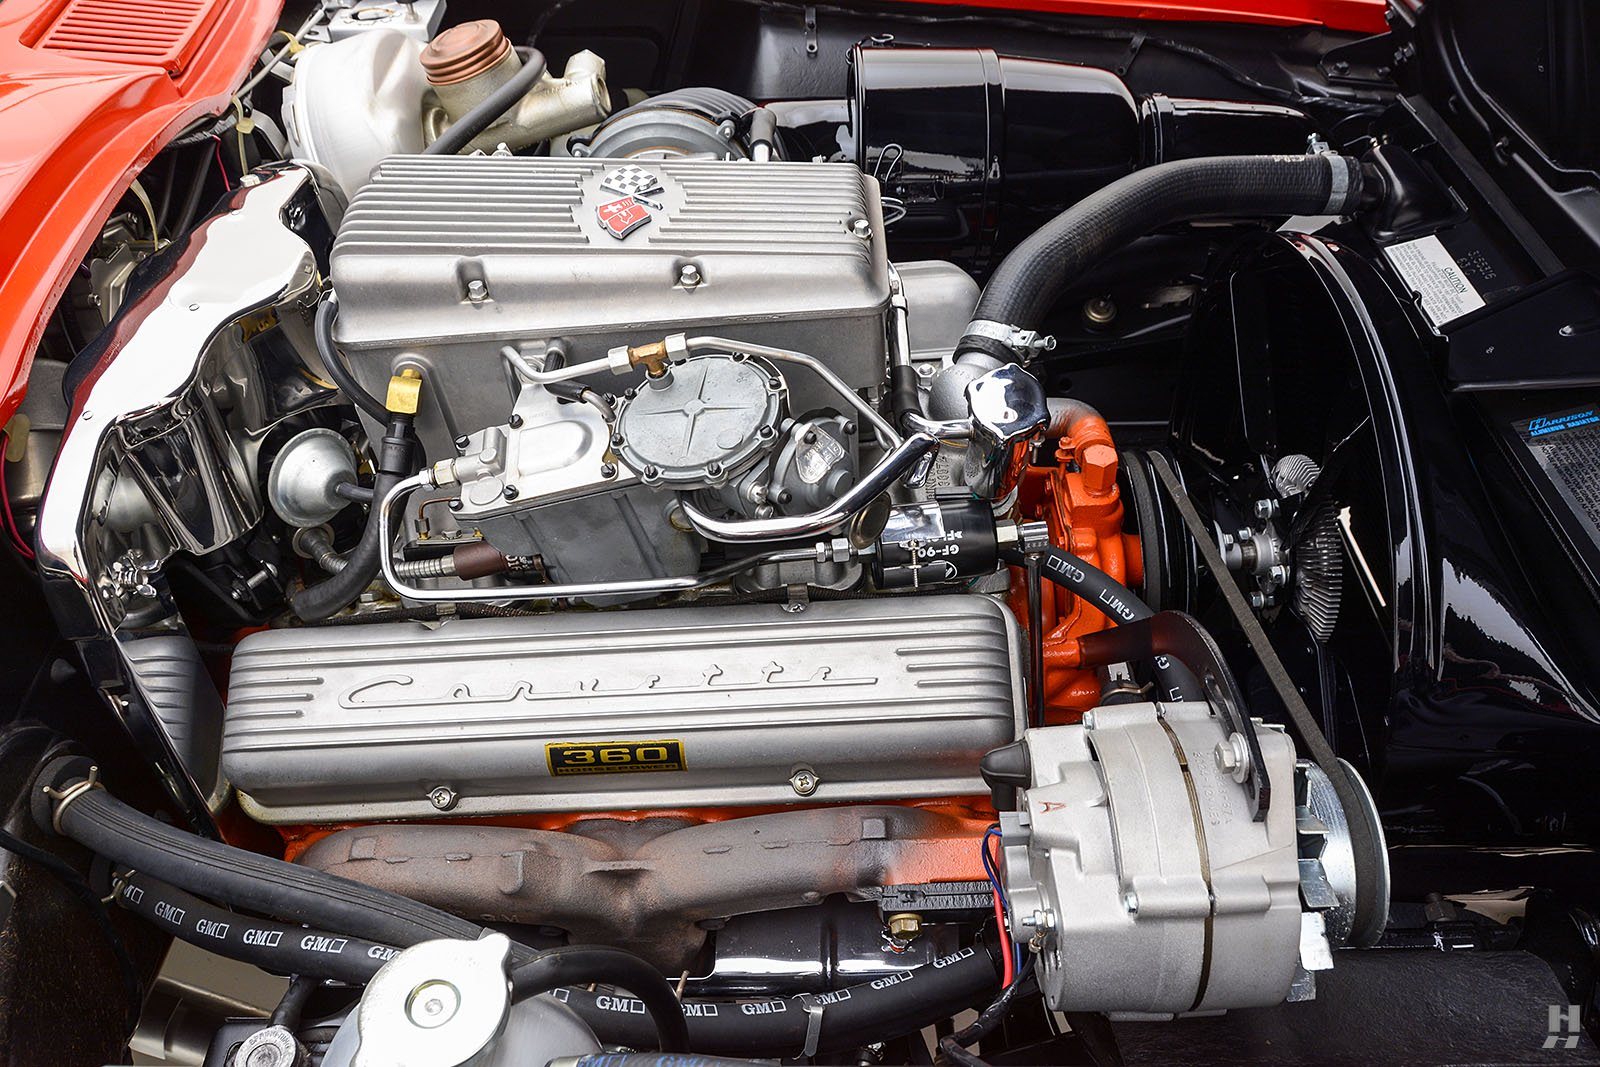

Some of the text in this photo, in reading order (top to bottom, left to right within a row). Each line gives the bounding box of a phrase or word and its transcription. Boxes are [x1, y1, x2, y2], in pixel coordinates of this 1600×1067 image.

[1444, 267, 1467, 292] CAUTION
[1530, 424, 1566, 437] ALUMINUM
[917, 544, 960, 559] GF-90
[1060, 561, 1086, 584] GM
[562, 746, 668, 765] 360
[558, 763, 678, 774] HORSEPOWER
[154, 901, 176, 921] GM
[196, 919, 218, 939] GM
[243, 929, 267, 946] GM
[300, 935, 330, 953] GM
[933, 952, 962, 968] GM
[870, 973, 901, 990] GM
[596, 995, 629, 1012] GM
[741, 1003, 772, 1015] GM
